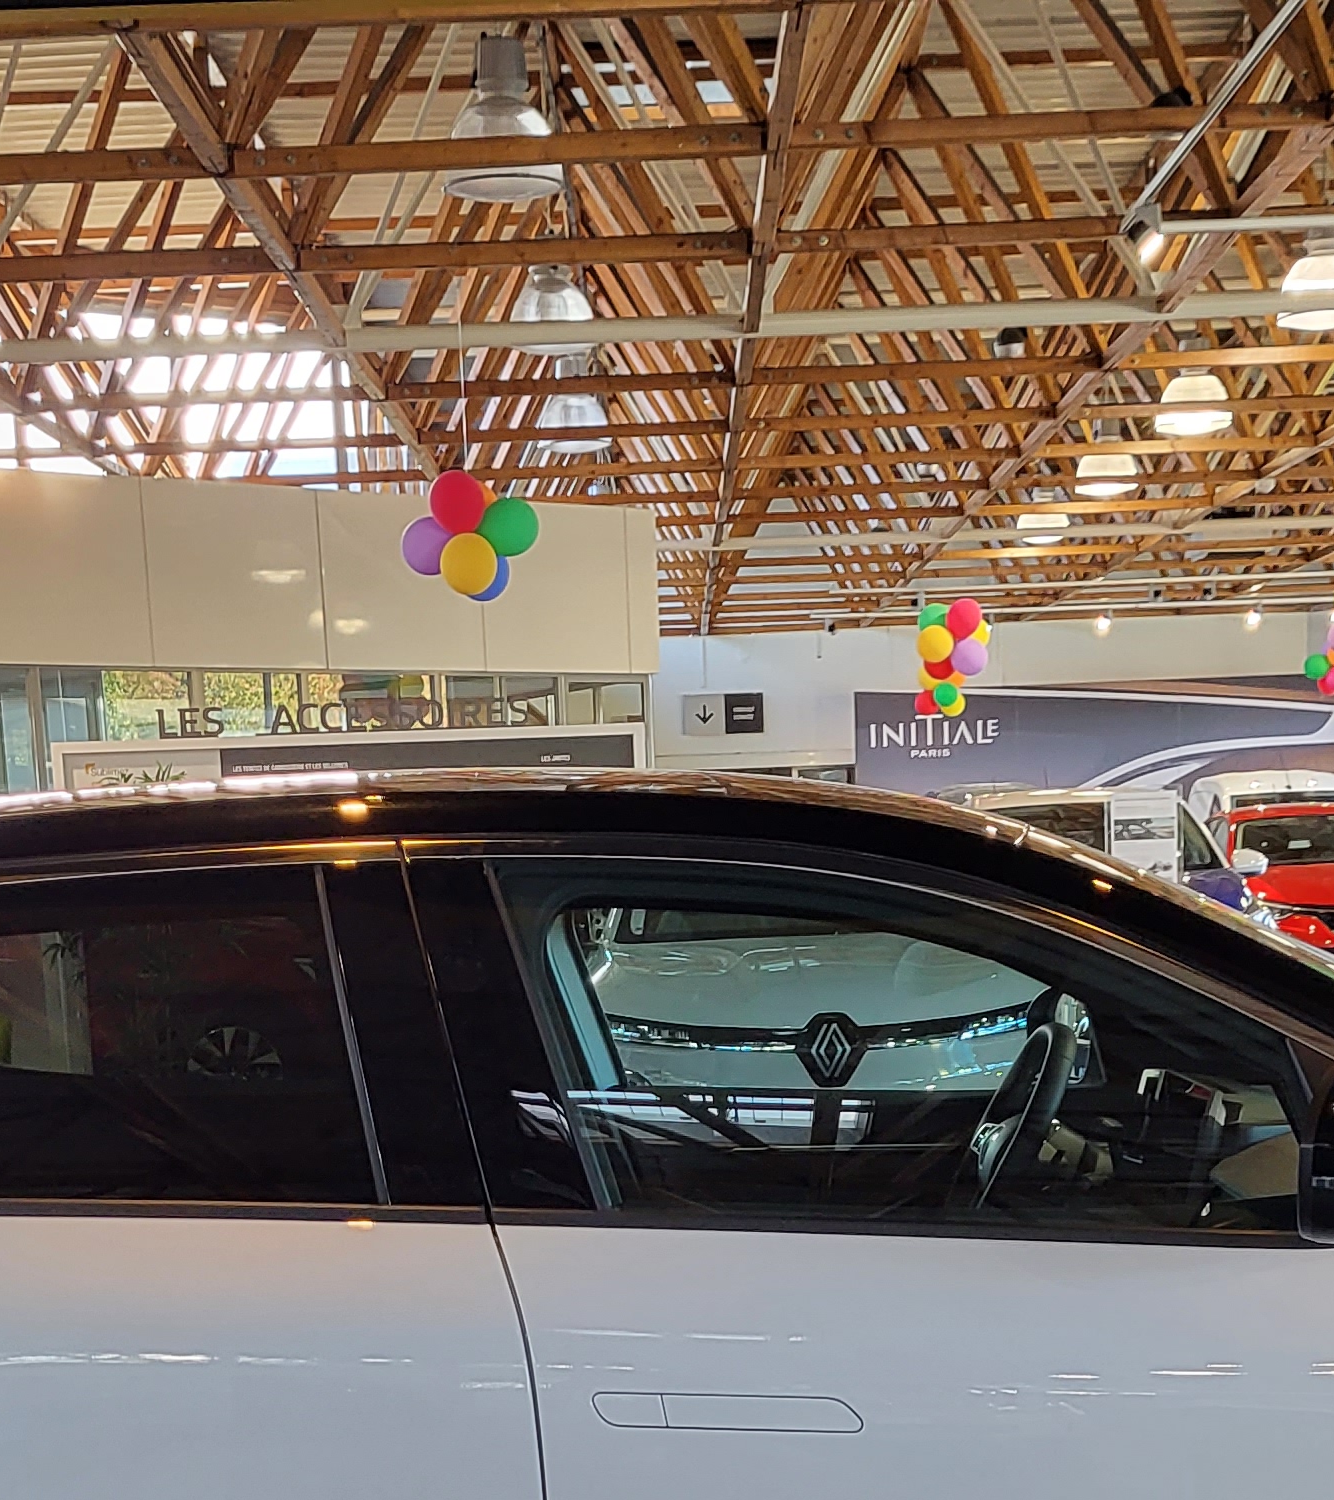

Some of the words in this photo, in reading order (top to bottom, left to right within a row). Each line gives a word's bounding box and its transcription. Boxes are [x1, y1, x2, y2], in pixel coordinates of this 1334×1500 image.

[155, 706, 225, 739] LES
[869, 713, 1000, 749] INITIALE
[910, 748, 951, 759] PARIS
